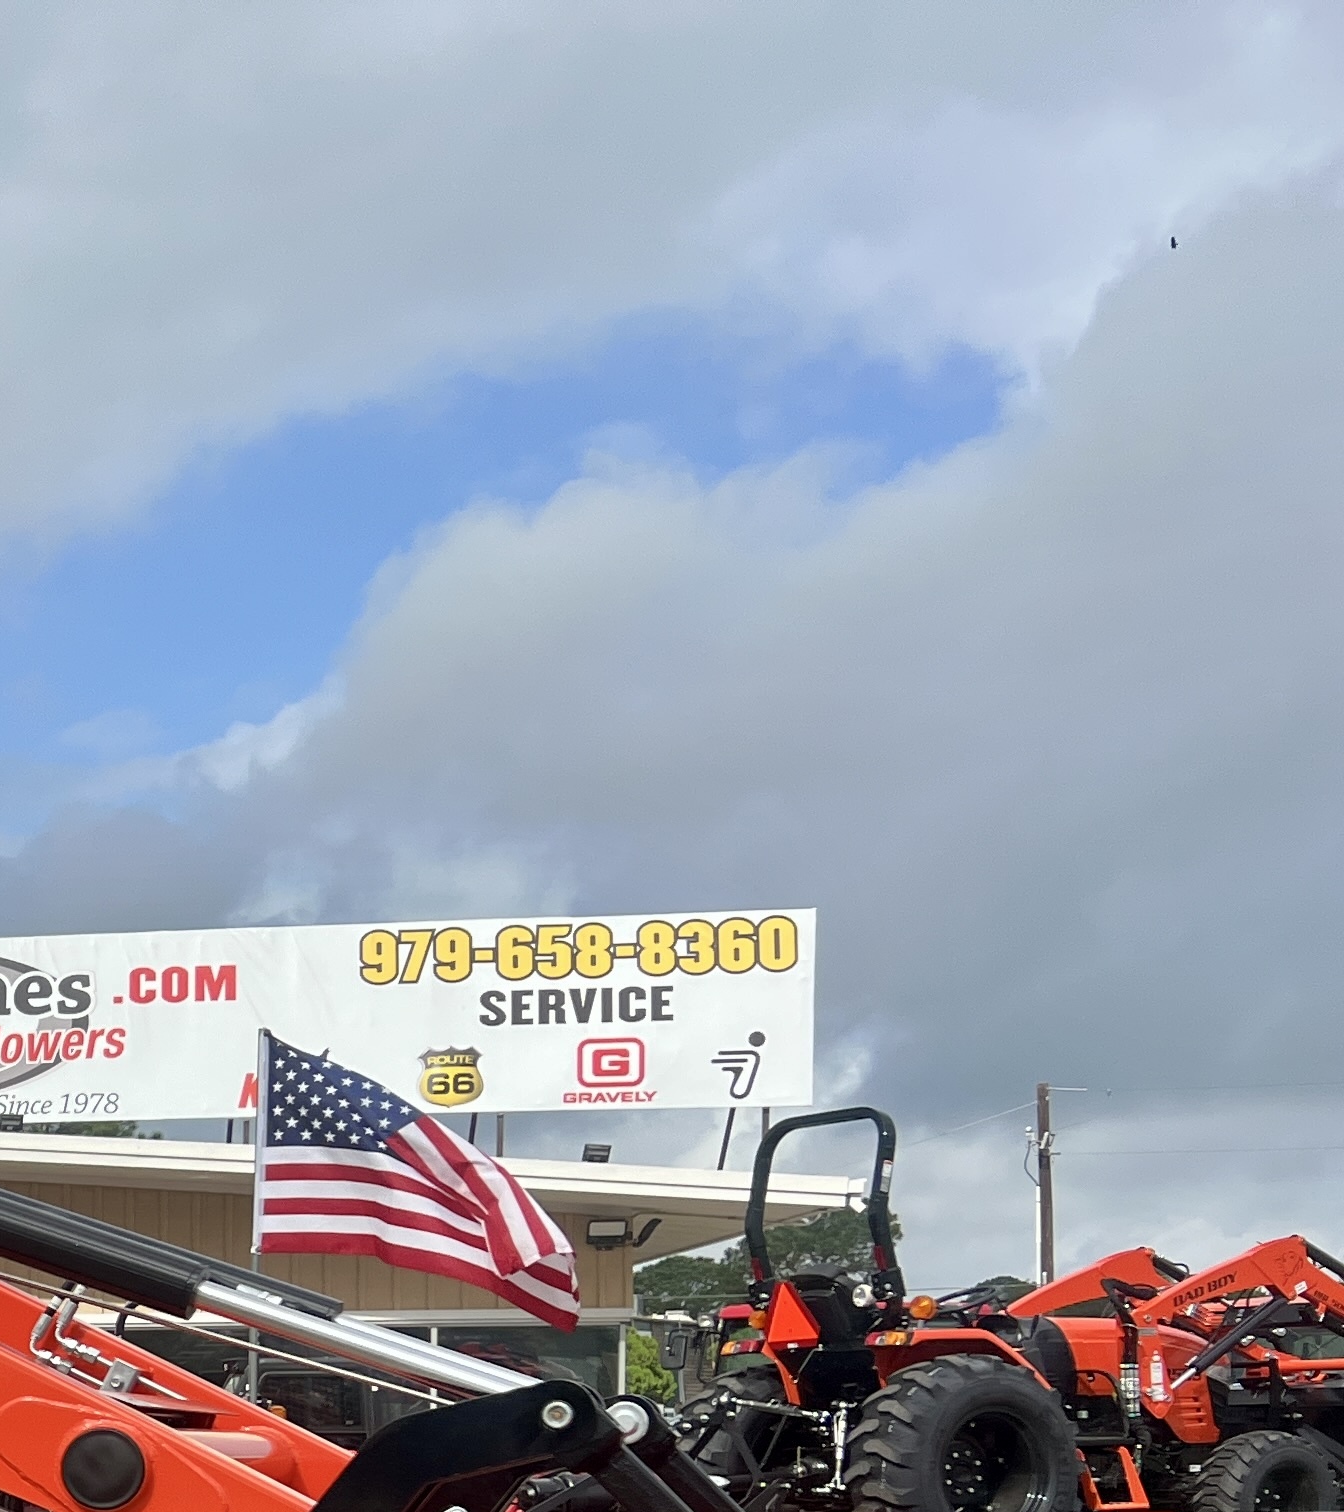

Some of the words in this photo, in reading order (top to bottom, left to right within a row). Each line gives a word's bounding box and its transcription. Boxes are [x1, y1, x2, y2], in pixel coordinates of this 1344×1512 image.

[359, 914, 799, 986] 979-658-8360
[112, 964, 238, 1005] .COM
[478, 985, 675, 1027] SERVICE
[426, 1054, 476, 1068] ROUTE
[426, 1072, 477, 1096] 66
[59, 1092, 120, 1116] 1978
[562, 1089, 658, 1105] GRAVELY
[1207, 1271, 1238, 1297] BOY
